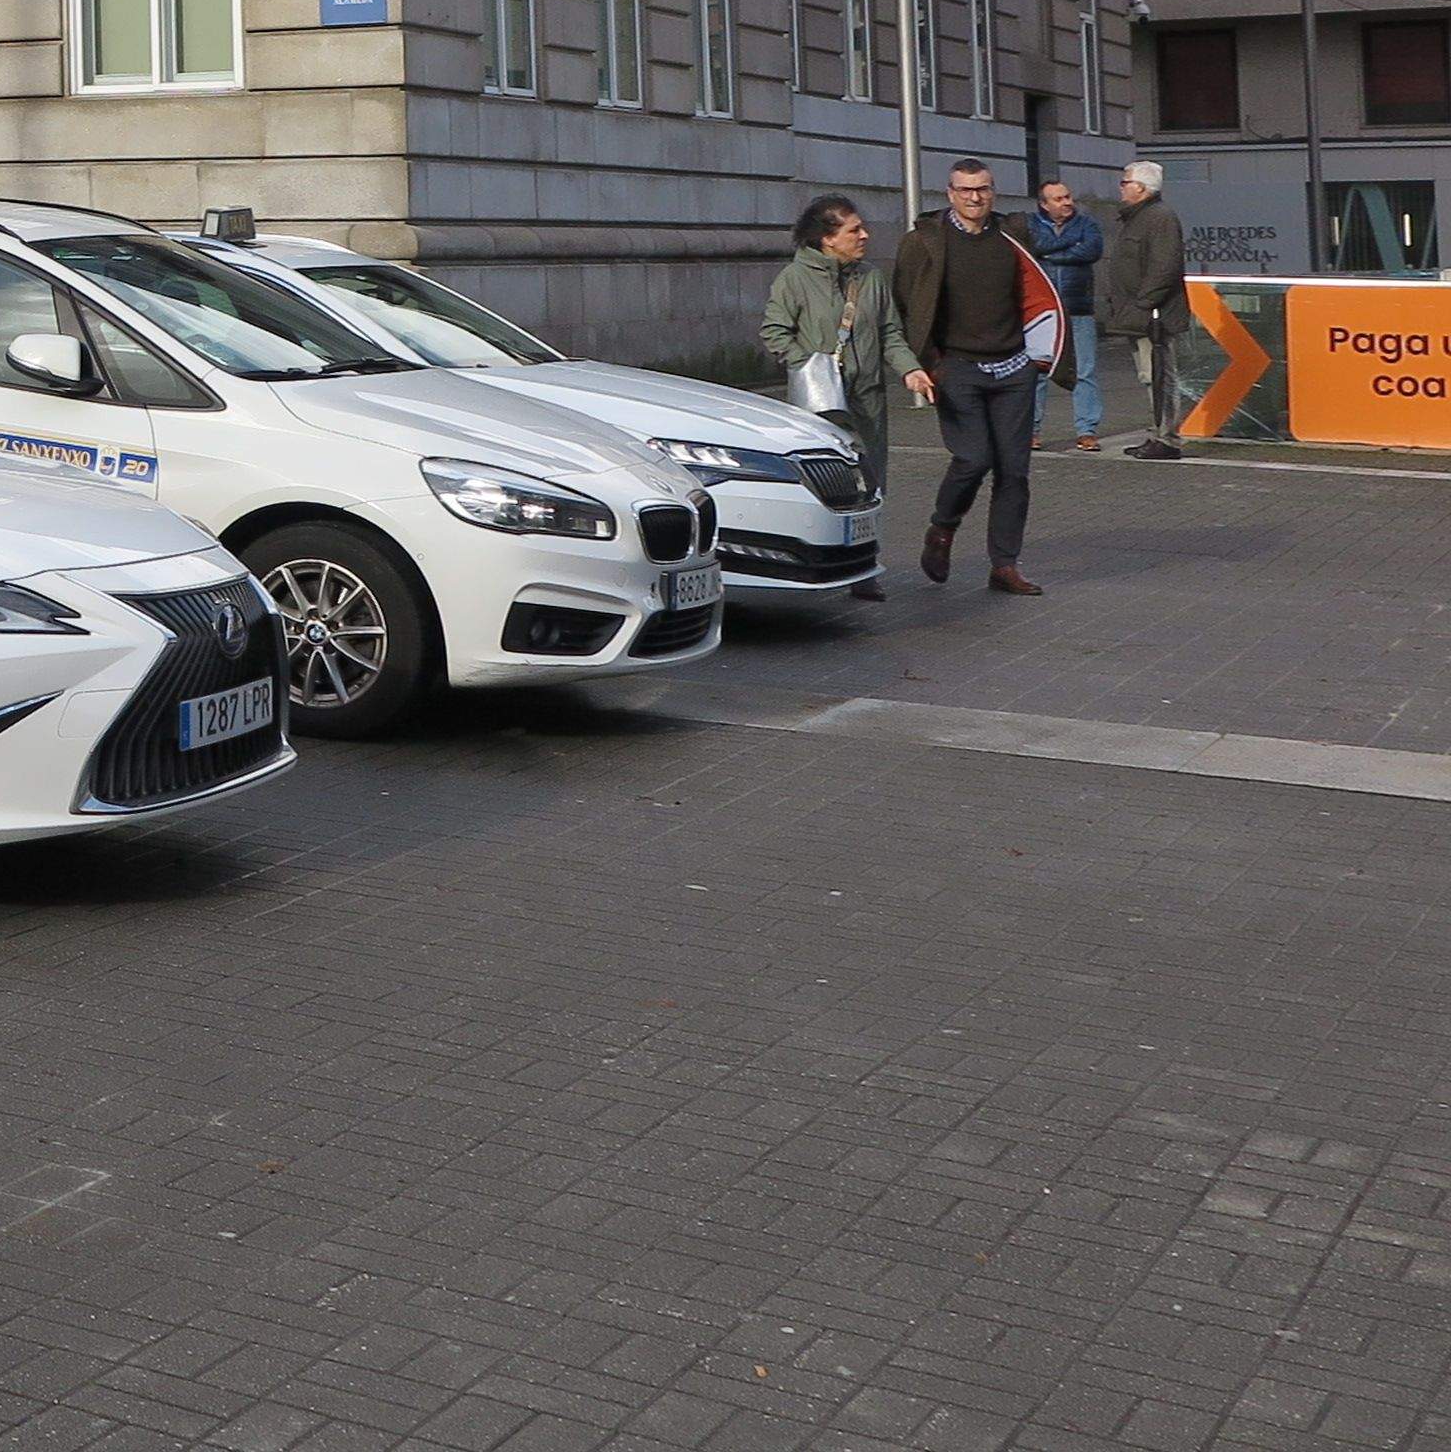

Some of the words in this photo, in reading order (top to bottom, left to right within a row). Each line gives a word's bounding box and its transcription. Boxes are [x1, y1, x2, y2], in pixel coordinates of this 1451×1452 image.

[1191, 226, 1277, 240] MERCEDES
[1328, 327, 1430, 364] Paga
[1371, 375, 1446, 398] coa
[11, 440, 92, 468] SANXENXO
[121, 458, 150, 477] 20
[197, 692, 239, 739] 1287
[243, 682, 271, 727] LPR
